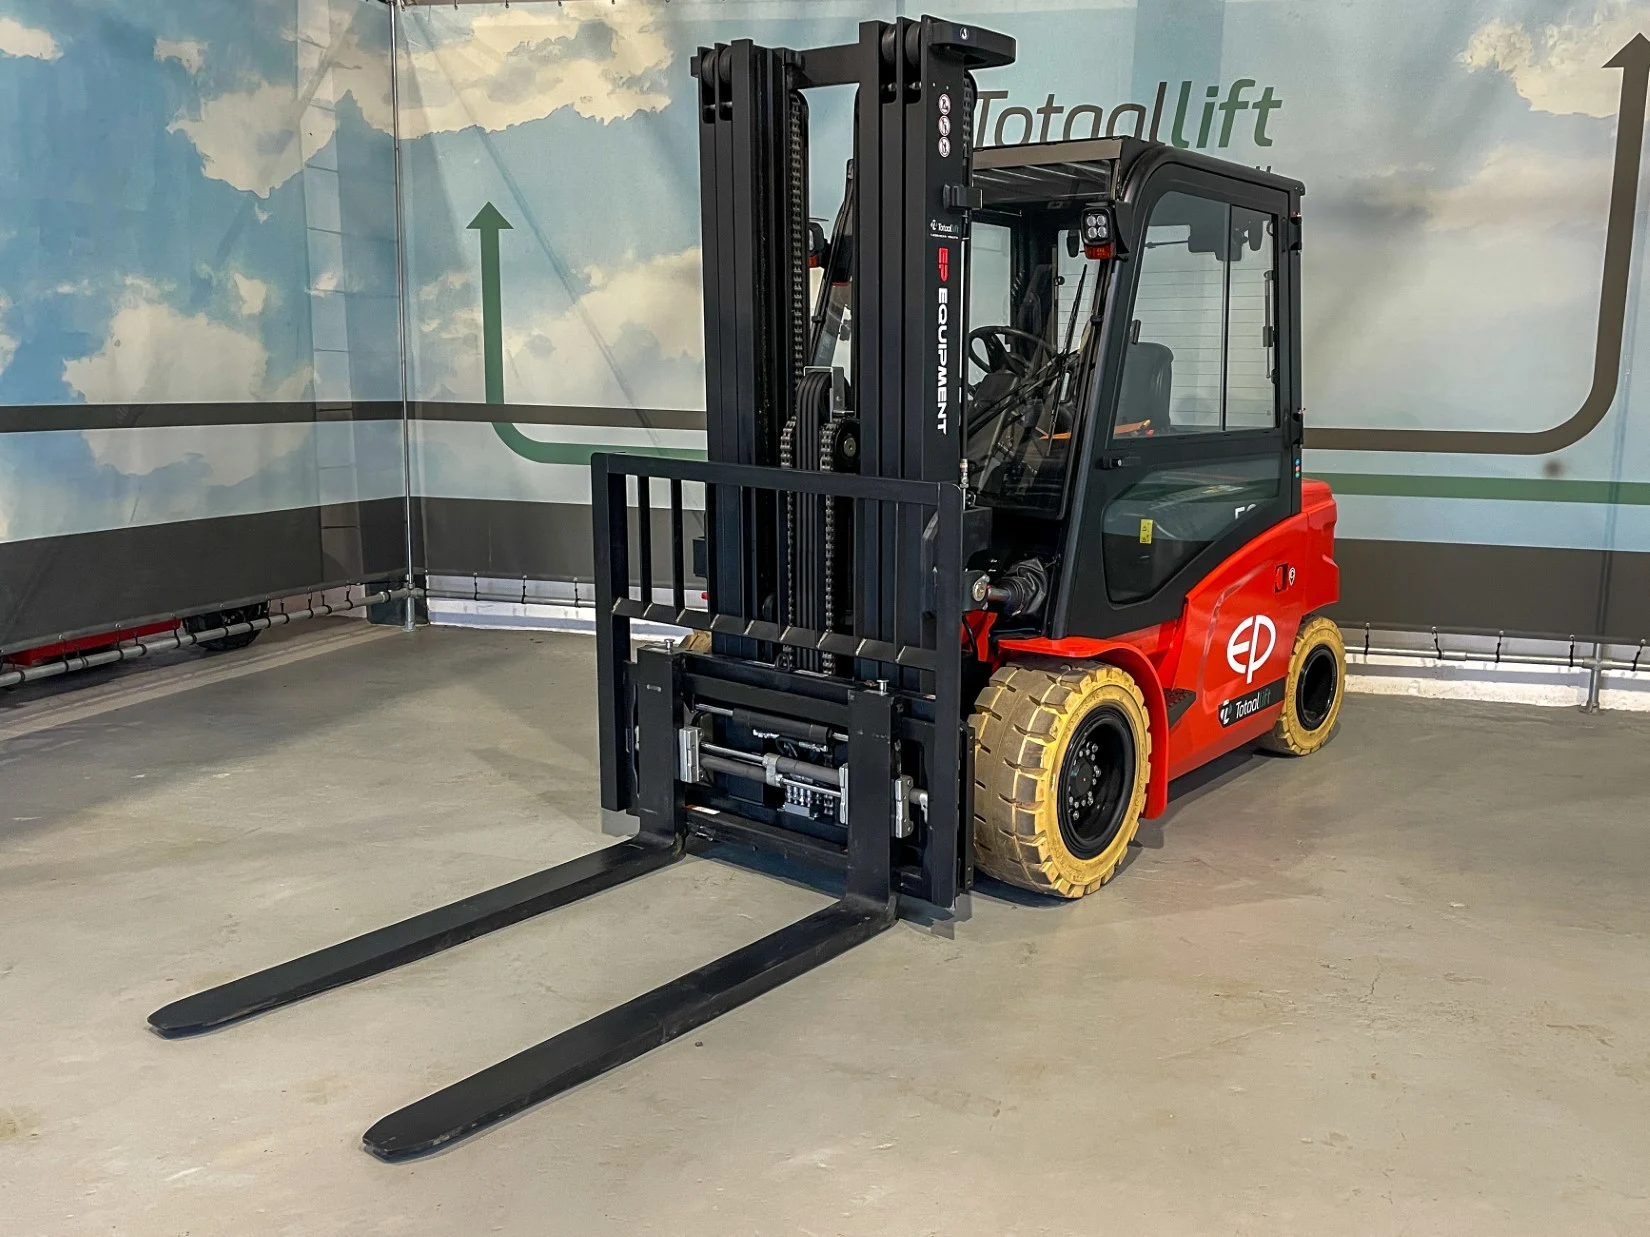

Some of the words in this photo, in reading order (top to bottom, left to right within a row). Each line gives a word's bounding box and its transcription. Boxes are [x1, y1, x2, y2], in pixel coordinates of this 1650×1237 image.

[938, 247, 949, 282] EP
[937, 288, 949, 435] EQUIPMENT
[1227, 614, 1276, 684] EP
